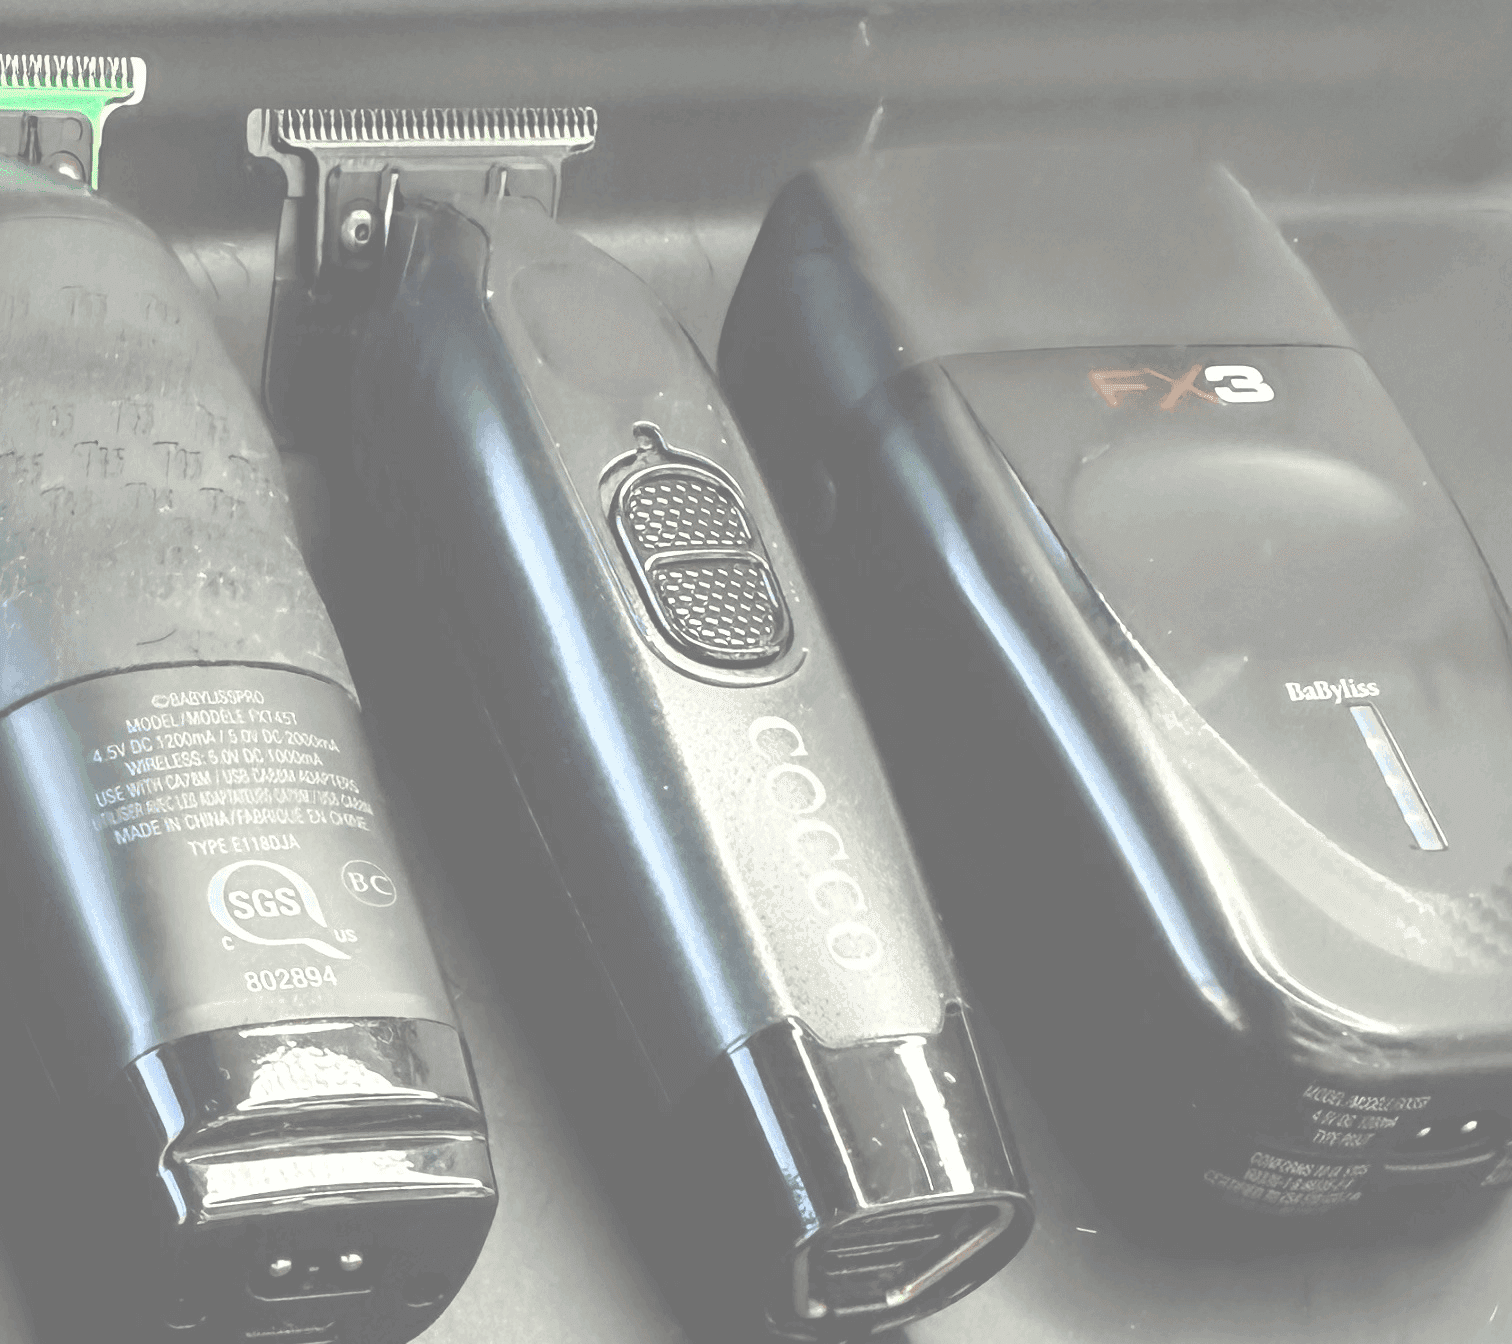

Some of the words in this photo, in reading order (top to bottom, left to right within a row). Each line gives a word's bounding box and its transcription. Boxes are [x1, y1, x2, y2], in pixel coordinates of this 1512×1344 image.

[1088, 363, 1276, 413] FX3
[1285, 679, 1381, 704] BaByliss
[130, 737, 154, 755] DC
[95, 786, 125, 808] USE
[114, 820, 163, 845] MADE
[164, 817, 183, 833] IN
[746, 715, 886, 971] COCCO
[188, 837, 229, 857] TYPE
[347, 871, 394, 896] BC
[229, 887, 302, 920] SGS
[333, 928, 359, 943] US
[244, 965, 338, 992] 802894
